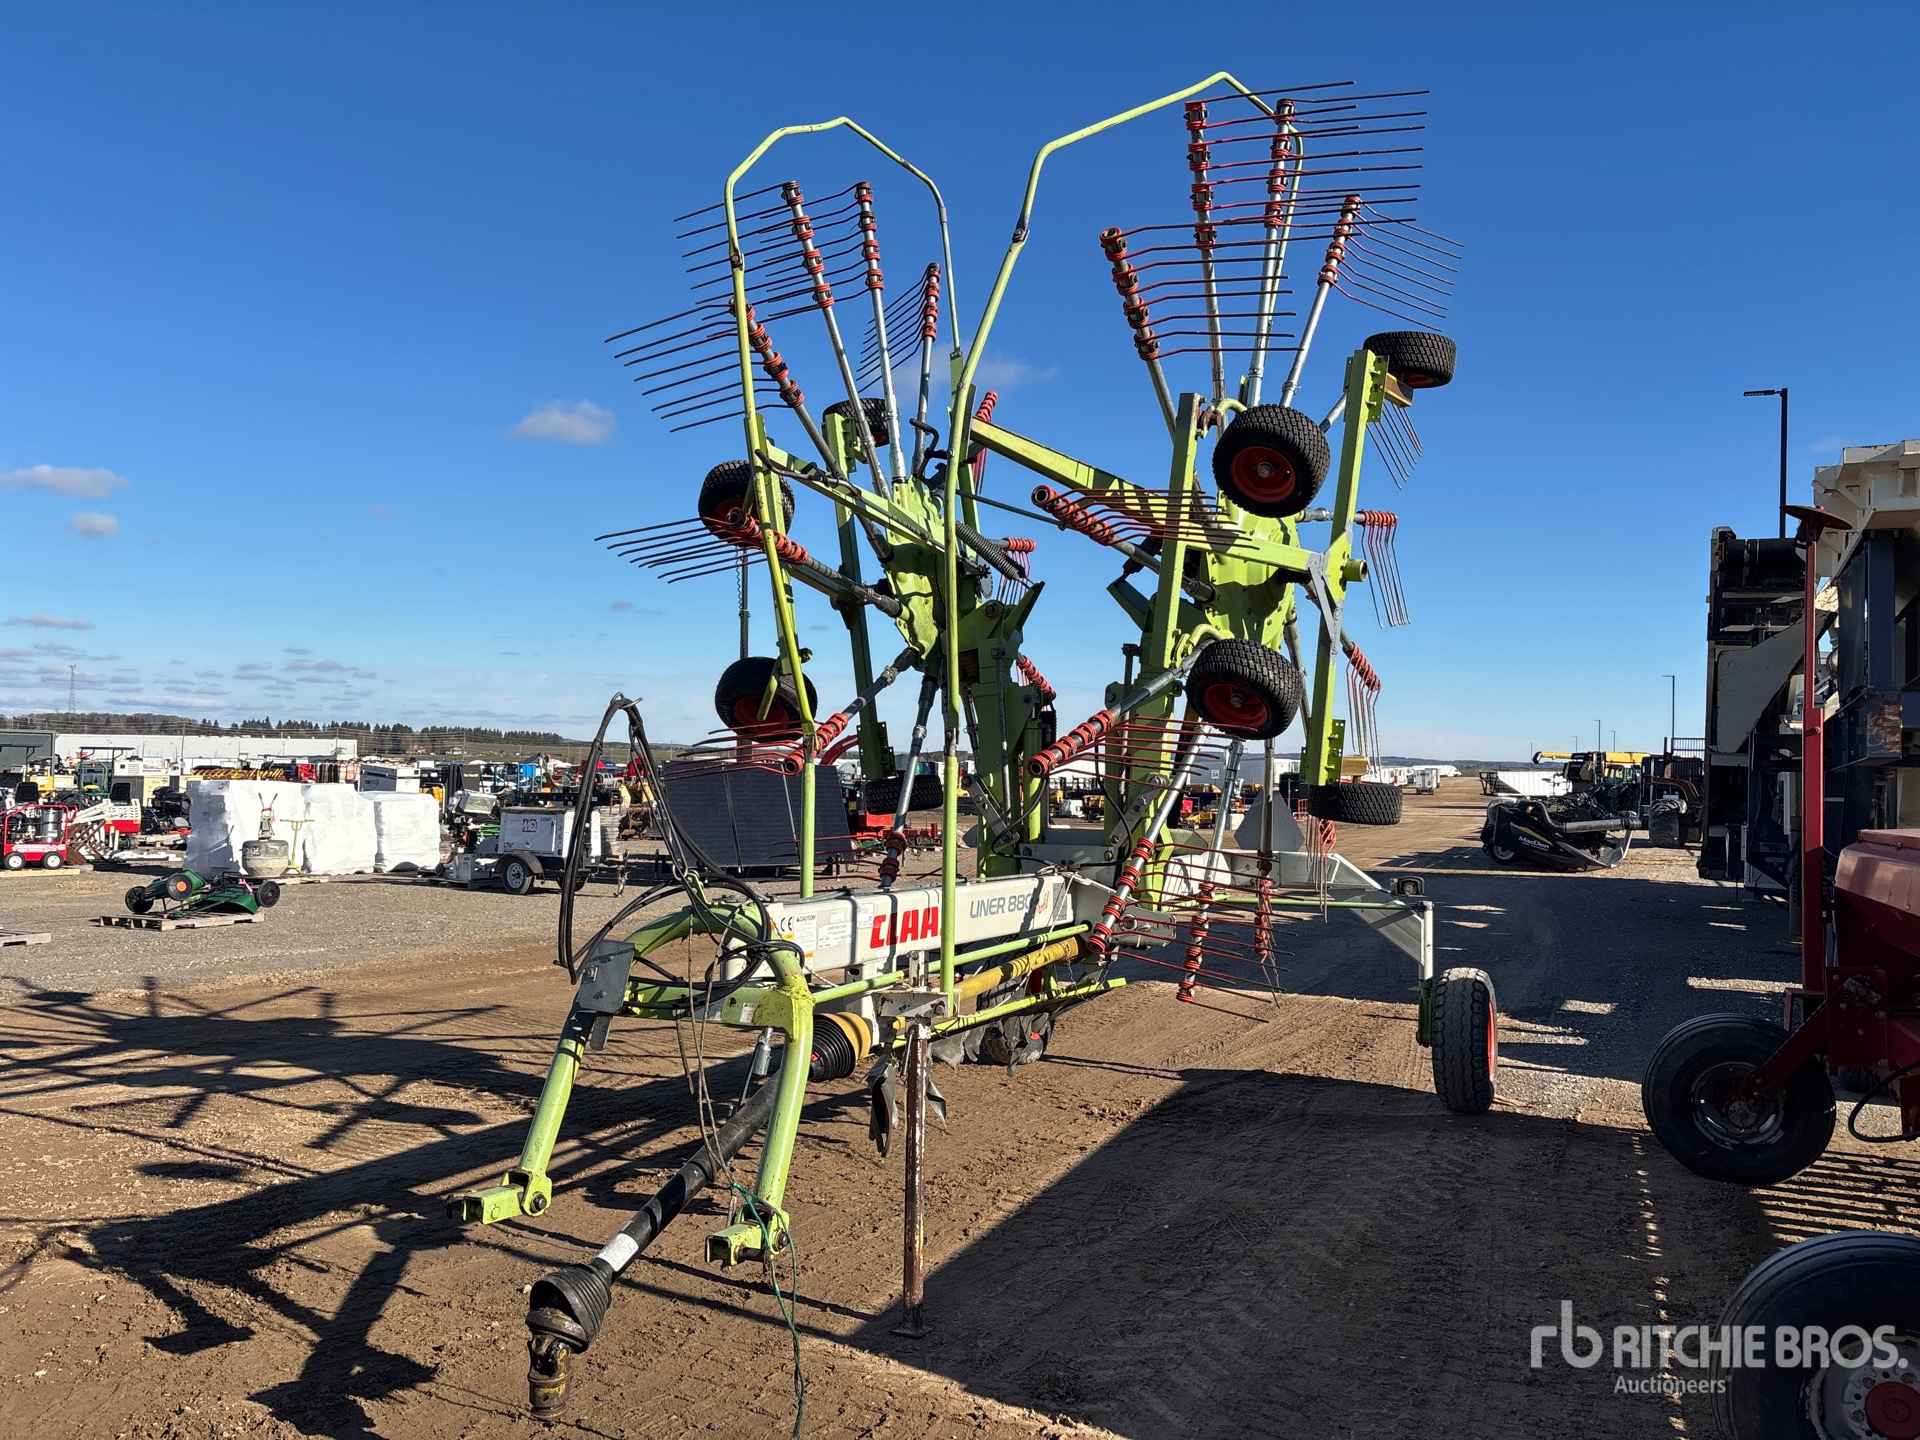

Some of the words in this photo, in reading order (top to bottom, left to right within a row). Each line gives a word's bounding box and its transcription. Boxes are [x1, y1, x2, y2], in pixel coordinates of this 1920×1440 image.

[1518, 835, 1550, 849] MacDon
[970, 897, 1006, 919] LINER
[869, 906, 943, 949] CLAA
